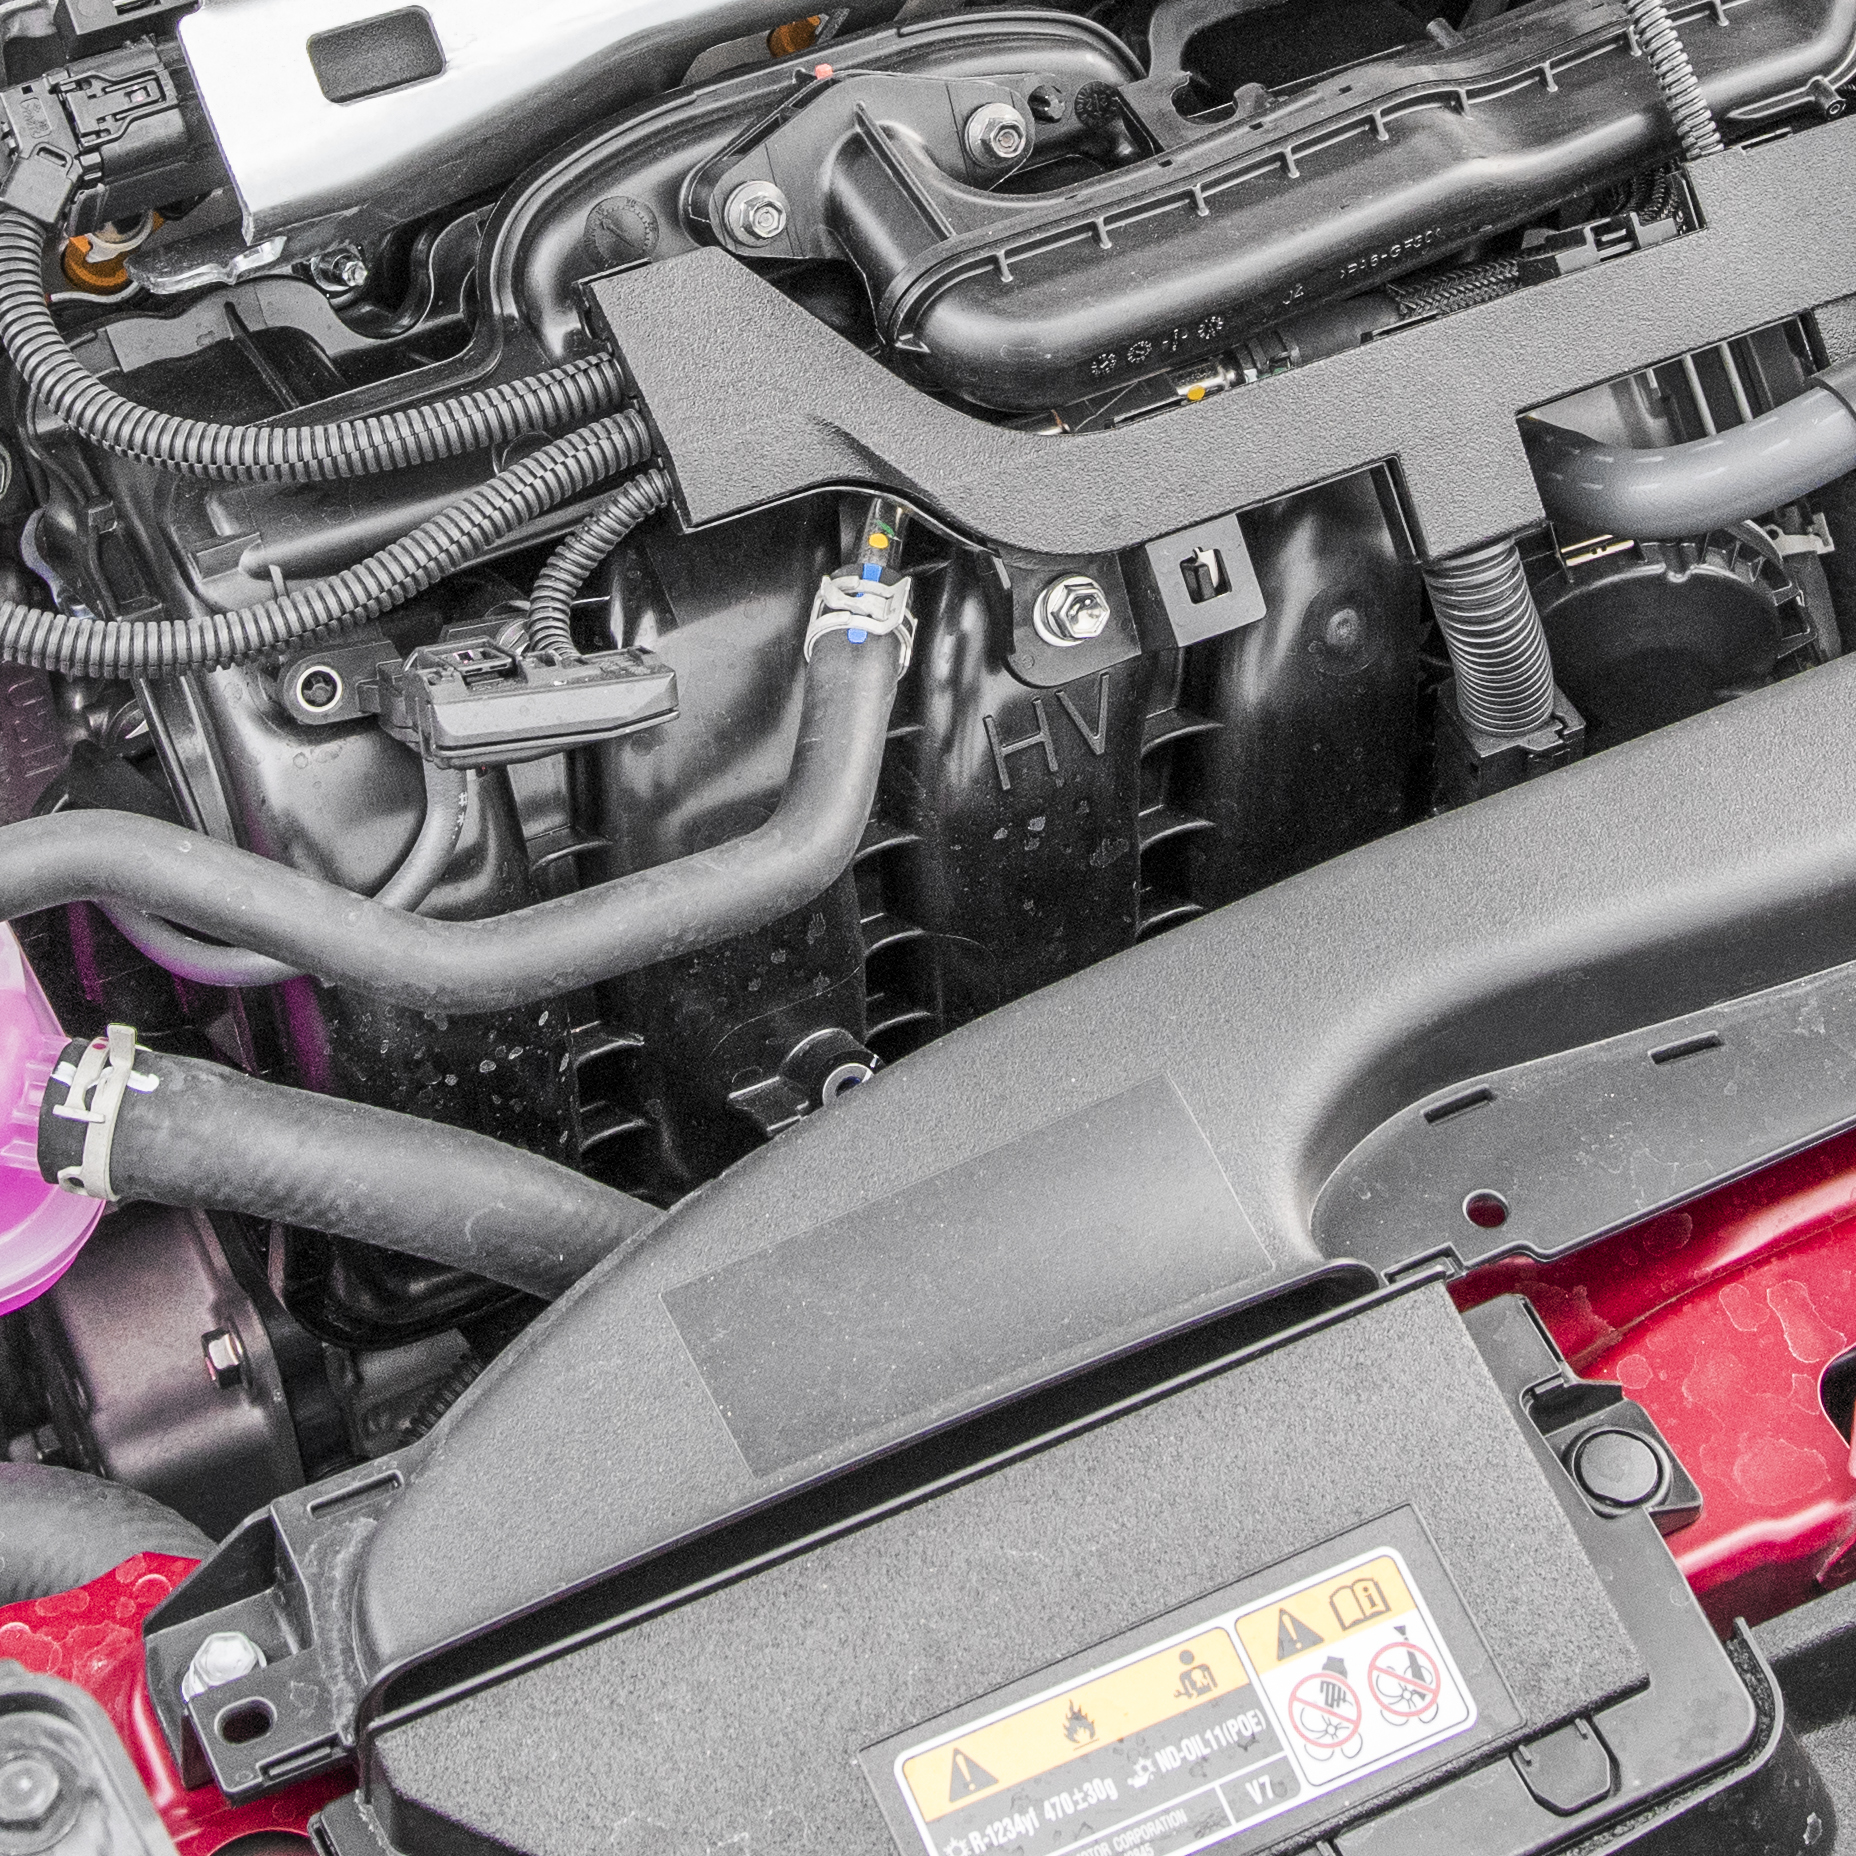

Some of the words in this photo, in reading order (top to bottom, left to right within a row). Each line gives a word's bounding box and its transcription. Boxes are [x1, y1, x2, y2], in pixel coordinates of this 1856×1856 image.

[983, 672, 1109, 791] HV
[968, 1808, 1041, 1854] R-1234yf
[1044, 1779, 1120, 1824] 470±30g
[1155, 1709, 1267, 1773] ND-OIL11(POE)
[1245, 1776, 1275, 1806] V7
[1112, 1807, 1188, 1852] CORPORATION
